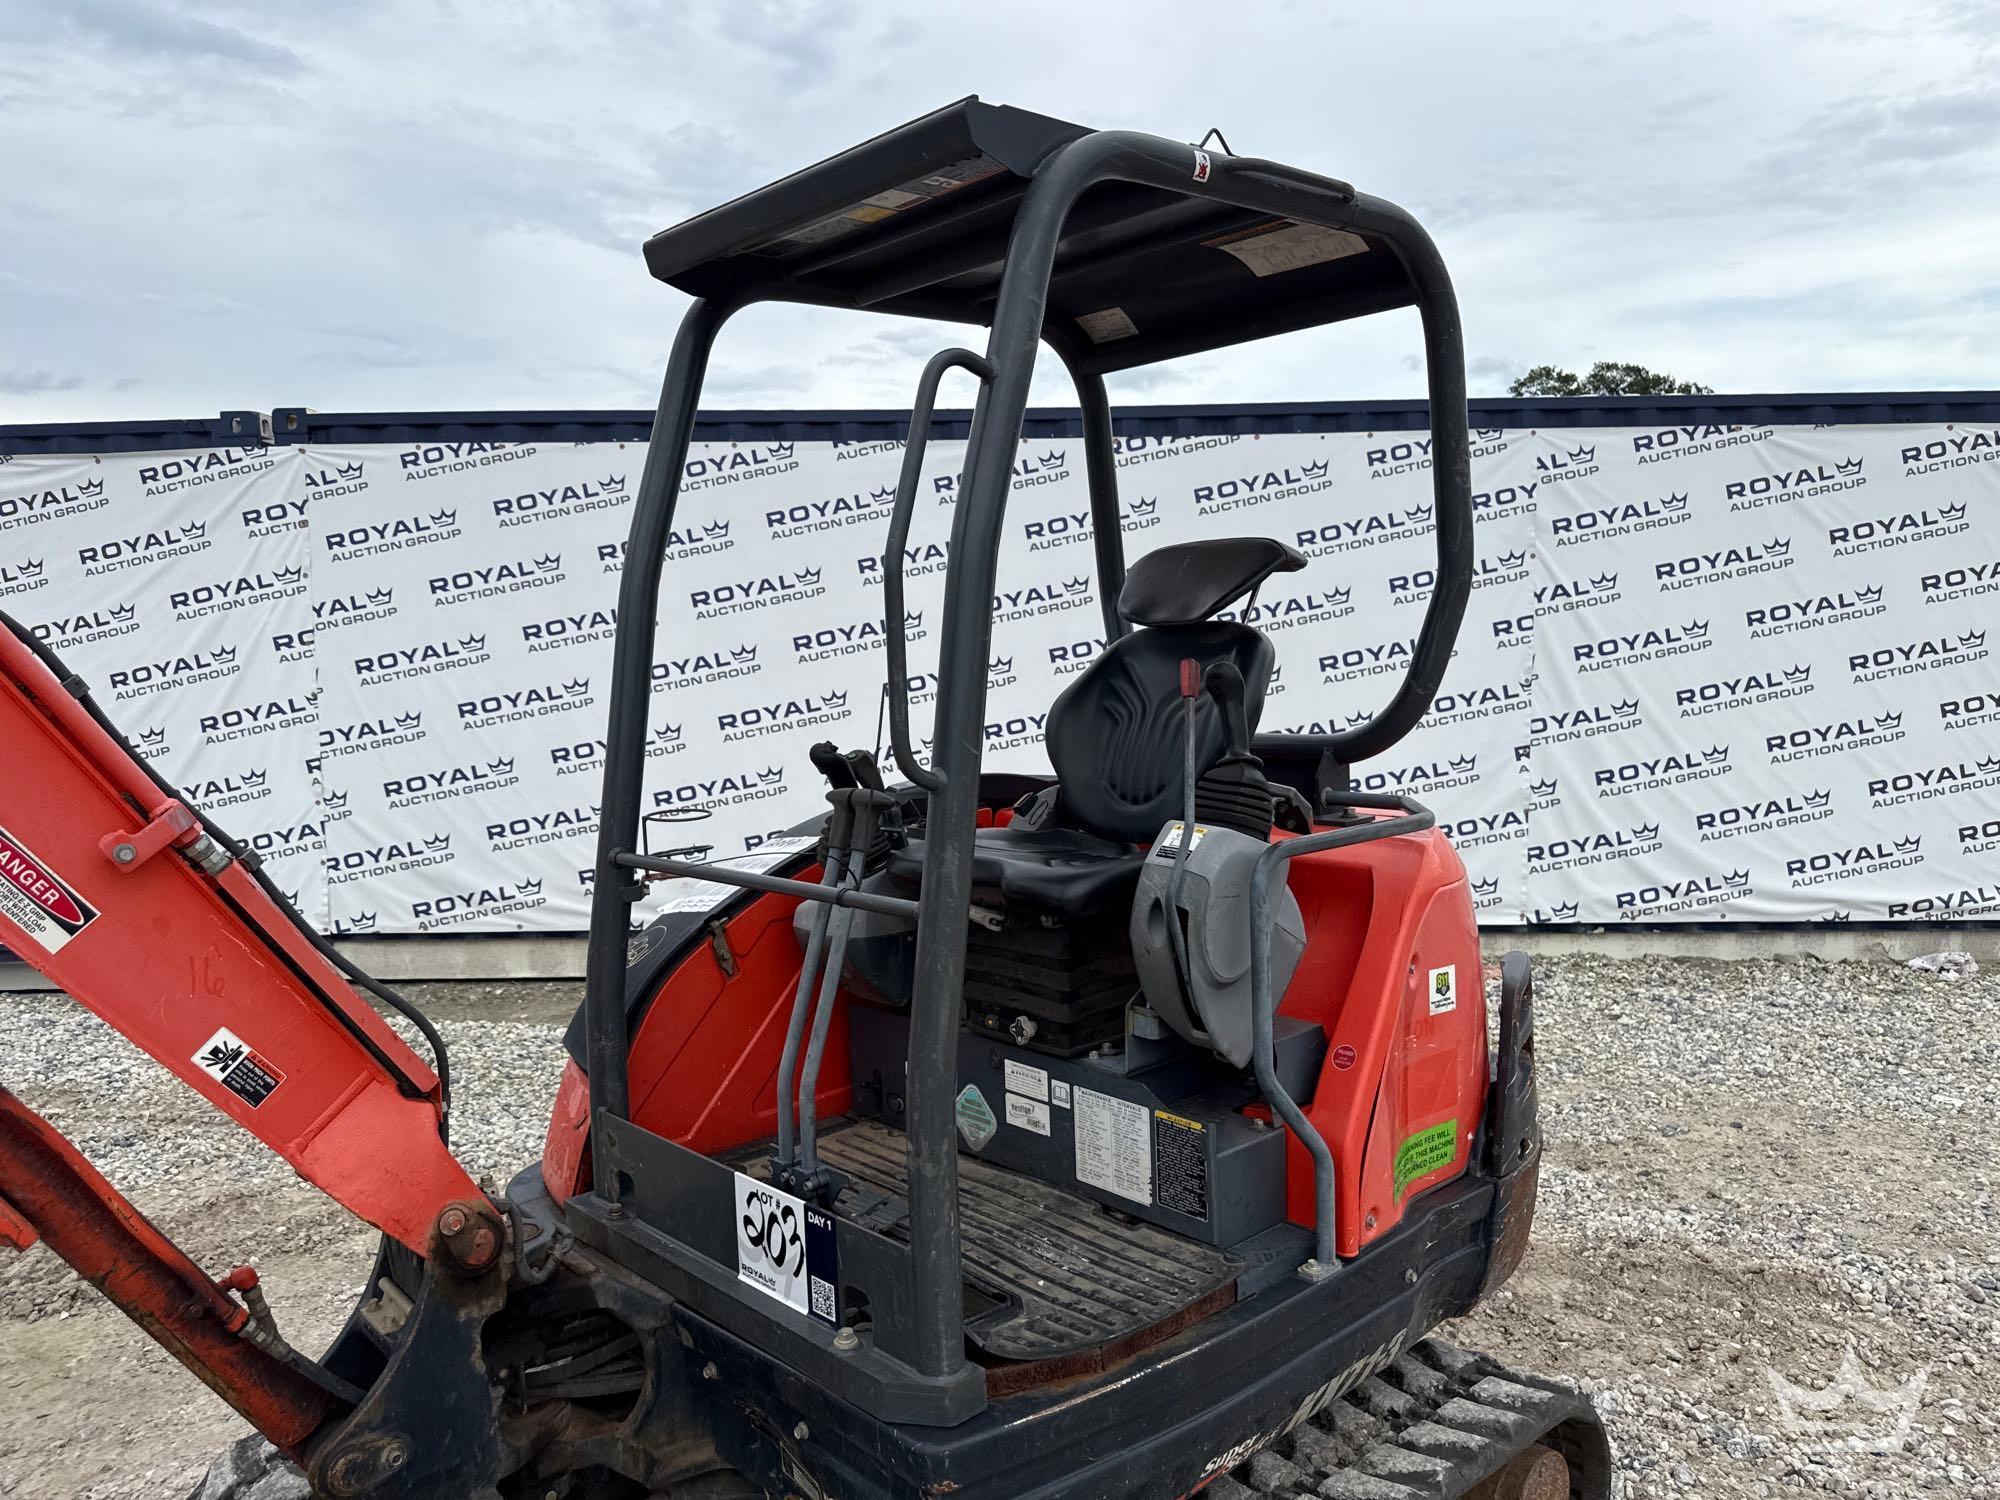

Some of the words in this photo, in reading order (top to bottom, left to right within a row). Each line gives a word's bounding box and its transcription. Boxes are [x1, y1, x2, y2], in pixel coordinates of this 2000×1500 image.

[1638, 442, 1712, 465] AUCTION
[1715, 430, 1774, 449] GROUP
[139, 449, 244, 485] ROYAL
[146, 473, 215, 497] AUCTION
[217, 460, 275, 480] GROUP
[406, 459, 477, 481] AUCTION
[480, 448, 536, 466] GROUP
[742, 461, 799, 480] GROUP
[1905, 454, 1980, 477] AUCTION
[1193, 469, 1302, 504] ROYAL
[1198, 493, 1271, 516] AUCTION
[1274, 480, 1332, 500] GROUP
[1726, 465, 1835, 500] ROYAL
[1730, 489, 1804, 512] AUCTION
[1807, 477, 1866, 497] GROUP
[493, 483, 600, 516] ROYAL
[499, 507, 571, 528] AUCTION
[573, 495, 630, 513] GROUP
[766, 494, 871, 528] ROYAL
[325, 517, 431, 551] ROYAL
[771, 518, 842, 540] AUCTION
[1296, 512, 1405, 548] ROYAL
[1378, 524, 1436, 543] GROUP
[1552, 501, 1661, 535] ROYAL
[1556, 525, 1630, 547] AUCTION
[1633, 513, 1692, 532] GROUP
[1829, 510, 1939, 545] ROYAL
[78, 530, 182, 565] ROYAL
[331, 540, 402, 563] AUCTION
[405, 528, 461, 547] GROUP
[1833, 535, 1908, 558] AUCTION
[1911, 523, 1970, 542] GROUP
[85, 553, 154, 577] AUCTION
[156, 540, 212, 560] GROUP
[1655, 546, 1763, 580] ROYAL
[1660, 570, 1733, 592] AUCTION
[1736, 558, 1794, 577] GROUP
[170, 574, 274, 610] ROYAL
[429, 562, 535, 595] ROYAL
[435, 585, 506, 607] AUCTION
[509, 573, 566, 592] GROUP
[690, 575, 796, 608] ROYAL
[1925, 582, 1999, 605] AUCTION
[176, 598, 245, 622] AUCTION
[248, 585, 307, 605] GROUP
[696, 598, 767, 620] AUCTION
[770, 587, 826, 605] GROUP
[1037, 596, 1093, 615] GROUP
[1746, 593, 1855, 627] ROYAL
[1750, 617, 1824, 640] AUCTION
[1828, 605, 1886, 624] GROUP
[354, 642, 460, 675] ROYAL
[528, 632, 599, 653] AUCTION
[798, 642, 868, 664] AUCTION
[1573, 628, 1682, 662] ROYAL
[1578, 651, 1652, 674] AUCTION
[1655, 640, 1712, 659] GROUP
[1849, 638, 1958, 672] ROYAL
[109, 654, 212, 689] ROYAL
[115, 677, 184, 701] AUCTION
[186, 665, 240, 684] GROUP
[360, 665, 431, 687] AUCTION
[434, 653, 490, 672] GROUP
[1323, 662, 1397, 685] AUCTION
[1853, 662, 1927, 684] AUCTION
[1930, 650, 1989, 669] GROUP
[457, 686, 564, 719] ROYAL
[1676, 672, 1783, 707] ROYAL
[1680, 696, 1753, 718] AUCTION
[1756, 684, 1814, 703] GROUP
[200, 696, 306, 733] ROYAL
[463, 709, 535, 731] AUCTION
[537, 697, 594, 716] GROUP
[717, 698, 822, 731] ROYAL
[723, 721, 794, 743] AUCTION
[796, 709, 852, 728] GROUP
[1416, 708, 1489, 730] AUCTION
[1584, 718, 1642, 737] GROUP
[206, 722, 276, 745] AUCTION
[370, 731, 426, 749] GROUP
[1766, 719, 1875, 753] ROYAL
[1770, 742, 1844, 765] AUCTION
[1847, 731, 1906, 750] GROUP
[383, 765, 489, 798] ROYAL
[1594, 753, 1702, 786] ROYAL
[1599, 776, 1672, 798] AUCTION
[1675, 765, 1732, 783] GROUP
[1868, 763, 1976, 797] ROYAL
[389, 788, 460, 810] AUCTION
[462, 776, 519, 795] GROUP
[653, 774, 758, 807] ROYAL
[732, 786, 788, 804] GROUP
[1872, 787, 1946, 809] AUCTION
[486, 808, 592, 841] ROYAL
[1696, 797, 1803, 830] ROYAL
[1700, 820, 1773, 842] AUCTION
[1776, 809, 1834, 827] GROUP
[492, 831, 563, 853] AUCTION
[1529, 853, 1602, 875] AUCTION
[1605, 842, 1663, 860] GROUP
[0, 844, 60, 906] ANGER
[327, 864, 397, 886] AUCTION
[399, 853, 455, 871] GROUP
[1786, 843, 1894, 876] ROYAL
[1792, 866, 1863, 889] AUCTION
[1866, 855, 1924, 873] GROUP
[0, 881, 20, 900] ATING
[30, 907, 47, 921] GRIP
[412, 886, 516, 919] ROYAL
[1616, 876, 1722, 909] ROYAL
[1620, 898, 1693, 921] AUCTION
[1696, 888, 1753, 906] GROUP
[1888, 887, 1996, 918] ROYAL
[1, 903, 37, 934] CENTERED
[11, 901, 30, 919] WITH
[28, 914, 47, 933] LOAD
[418, 908, 489, 931] AUCTION
[490, 897, 546, 915] GROUP
[257, 1059, 282, 1079] WARNING
[1415, 1148, 1428, 1160] THIS
[1428, 1137, 1455, 1153] MACHINE
[1424, 1134, 1436, 1144] FEE
[1436, 1129, 1451, 1139] WILL
[1428, 1151, 1448, 1164] CLEAN
[743, 1190, 805, 1278] 203
[808, 1211, 825, 1228] DAY
[826, 1220, 832, 1231] 1
[741, 1263, 769, 1283] ROYAL
